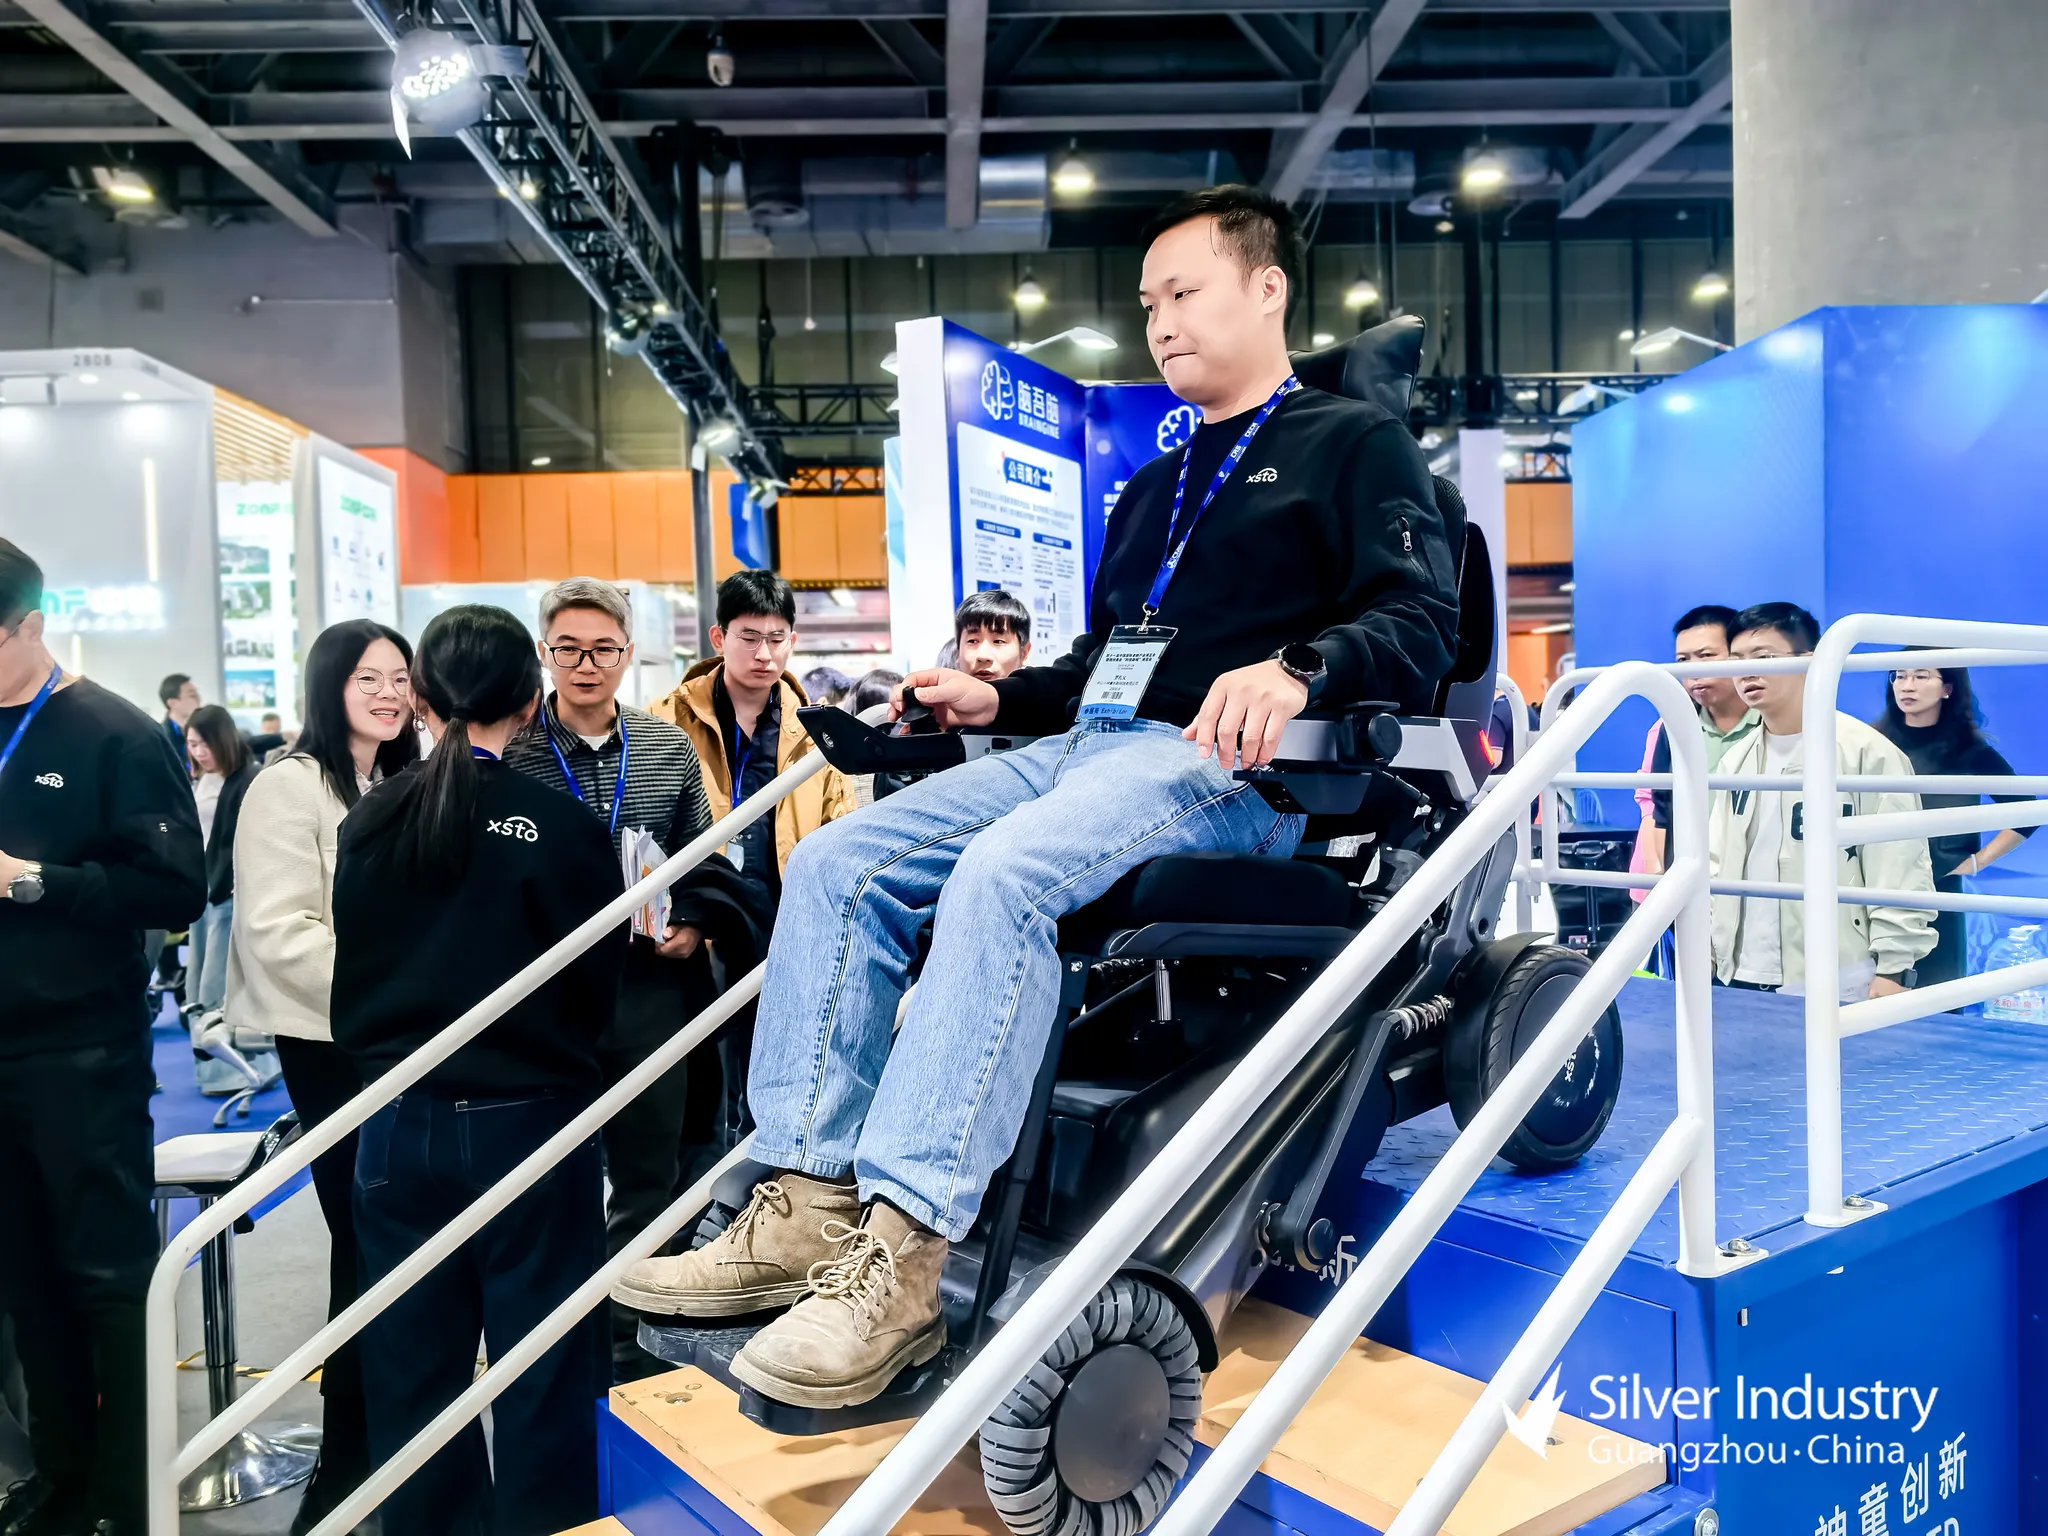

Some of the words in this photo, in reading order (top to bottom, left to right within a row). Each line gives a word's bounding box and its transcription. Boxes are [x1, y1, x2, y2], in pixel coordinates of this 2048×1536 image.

[1245, 468, 1278, 483] xsto
[35, 772, 64, 788] xsto
[486, 816, 539, 842] xsto
